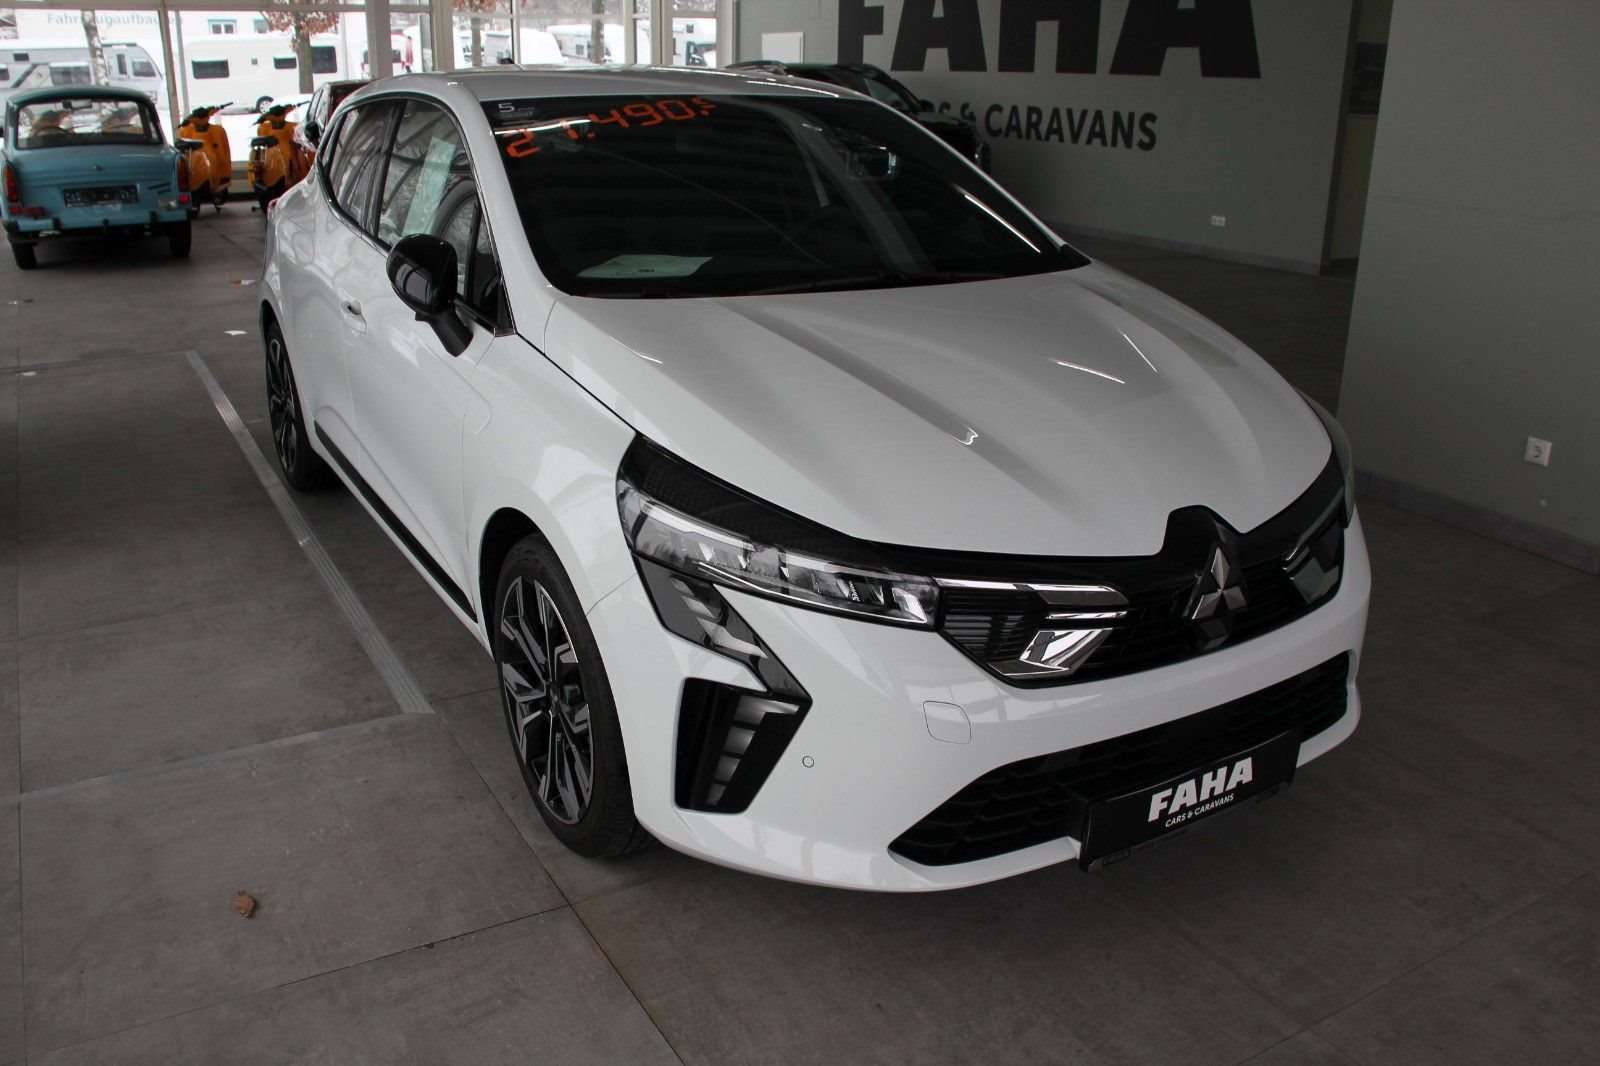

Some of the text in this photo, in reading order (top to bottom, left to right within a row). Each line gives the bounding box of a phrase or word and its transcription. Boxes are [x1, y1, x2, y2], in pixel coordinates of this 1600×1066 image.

[984, 104, 1158, 151] CARAVANS
[1147, 756, 1253, 823] FAHA
[1165, 813, 1186, 828] CARS
[1194, 793, 1235, 816] CARAVANS
